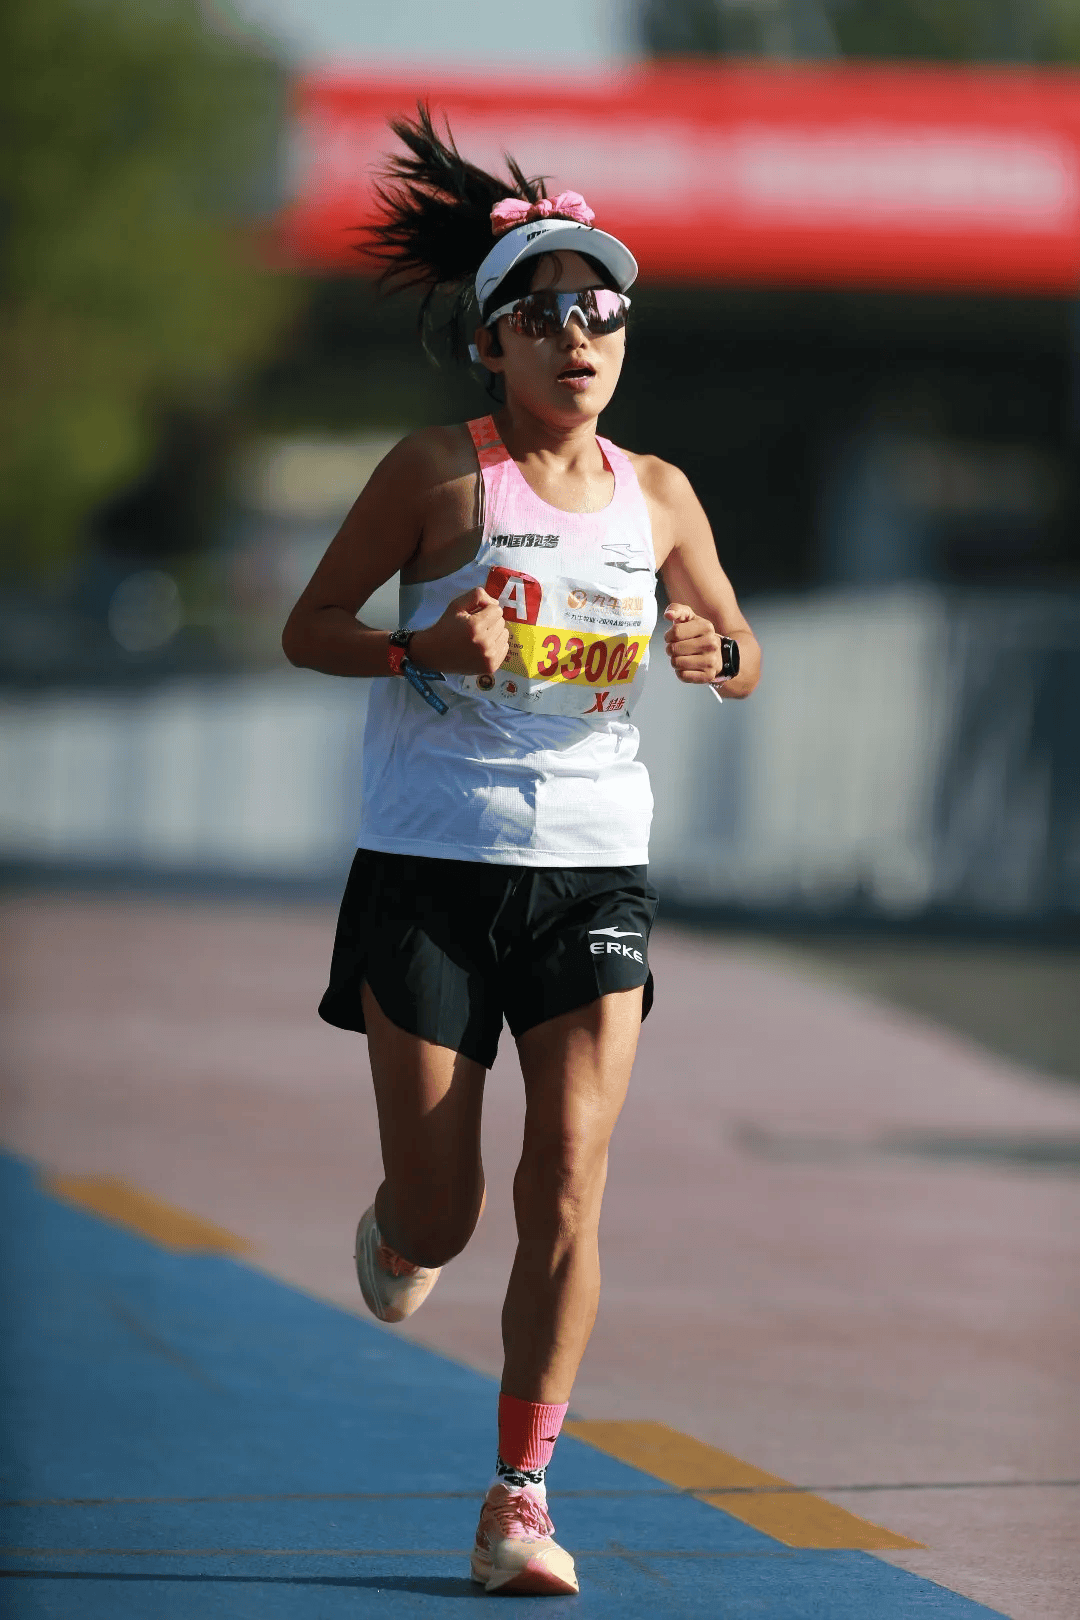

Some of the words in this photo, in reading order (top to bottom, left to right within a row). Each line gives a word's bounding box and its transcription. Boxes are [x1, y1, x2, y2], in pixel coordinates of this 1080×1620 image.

[497, 575, 528, 621] A
[537, 634, 640, 683] 33002
[589, 941, 644, 965] ERKE
